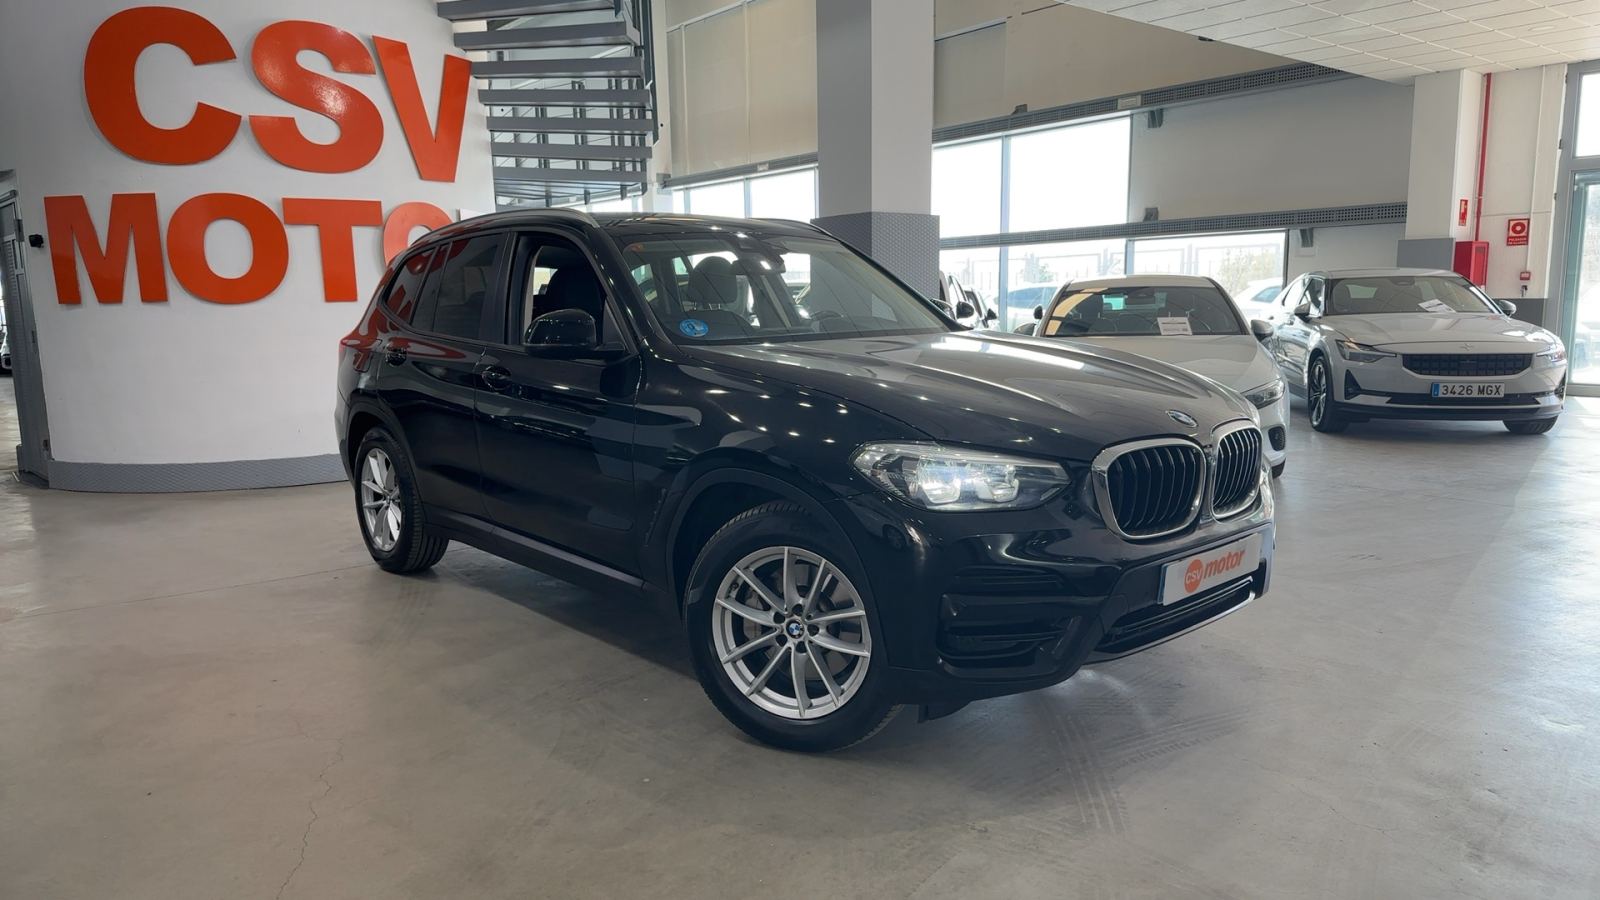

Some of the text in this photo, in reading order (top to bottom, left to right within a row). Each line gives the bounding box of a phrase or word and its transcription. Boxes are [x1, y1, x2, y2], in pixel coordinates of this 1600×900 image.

[83, 6, 472, 183] CSV
[44, 192, 484, 304] MOT
[1441, 384, 1502, 396] 3426 MGX
[1203, 549, 1246, 579] motor
